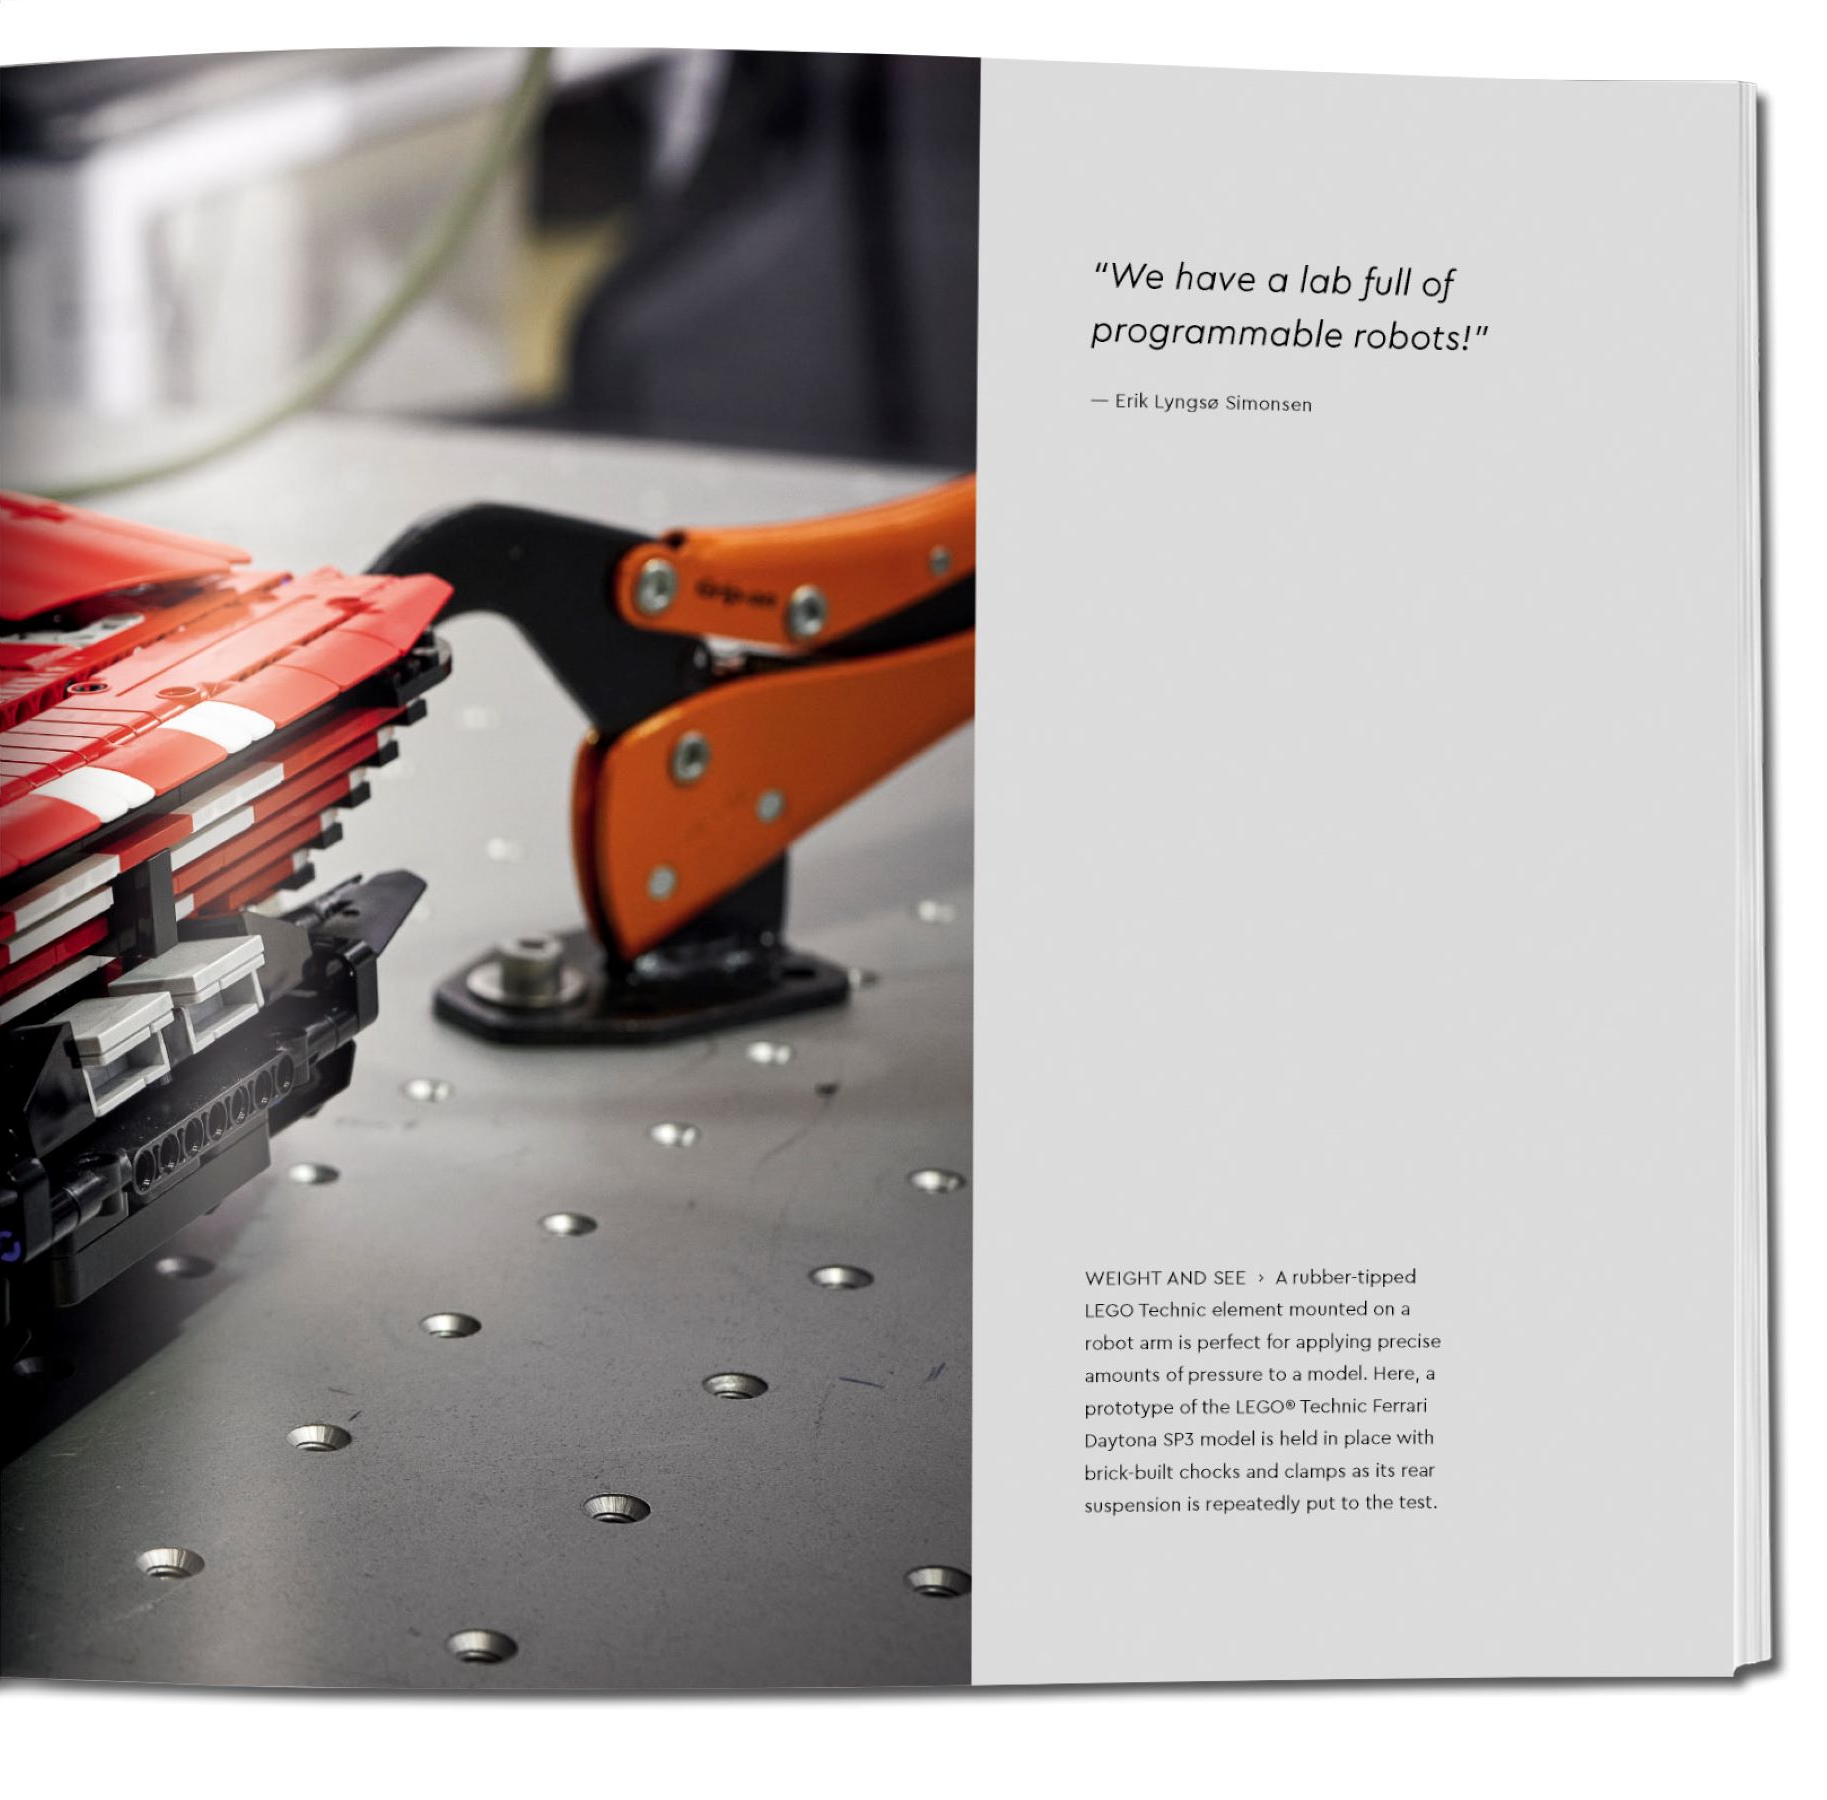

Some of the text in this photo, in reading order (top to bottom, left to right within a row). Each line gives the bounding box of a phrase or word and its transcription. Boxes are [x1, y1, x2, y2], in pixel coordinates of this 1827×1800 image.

[1175, 260, 1256, 293] have
[1267, 272, 1289, 294] a
[1299, 264, 1352, 296] lab
[1357, 265, 1413, 303] full
[1421, 266, 1458, 305] of
[1090, 317, 1344, 351] programmable
[1115, 391, 1149, 409] Erik
[1154, 393, 1220, 414] Lyngsø
[1225, 394, 1312, 413] Simonsen
[1084, 1270, 1163, 1287] WEIGHT
[1166, 1270, 1208, 1286] AND
[1213, 1270, 1247, 1286] SEE
[1275, 1269, 1288, 1286] A
[1292, 1267, 1417, 1288] rubber-tipped
[1085, 1299, 1411, 1319] LEGO Technic element mounted on a
[1085, 1332, 1442, 1354] robot arm is perfect for applying precise
[1084, 1363, 1436, 1386] amounts of pressure to a model. Here, a
[1085, 1400, 1174, 1420] prototype
[1179, 1398, 1199, 1415] of
[1201, 1397, 1231, 1416] the
[1299, 1397, 1368, 1415] Technic
[1373, 1397, 1428, 1414] Ferrari
[1085, 1427, 1434, 1452] Daytona SP3 model is held in place with
[1084, 1461, 1436, 1482] brick-built chocks and clamps as its rear
[1084, 1493, 1438, 1517] suspension is repeatedly put to the test.
